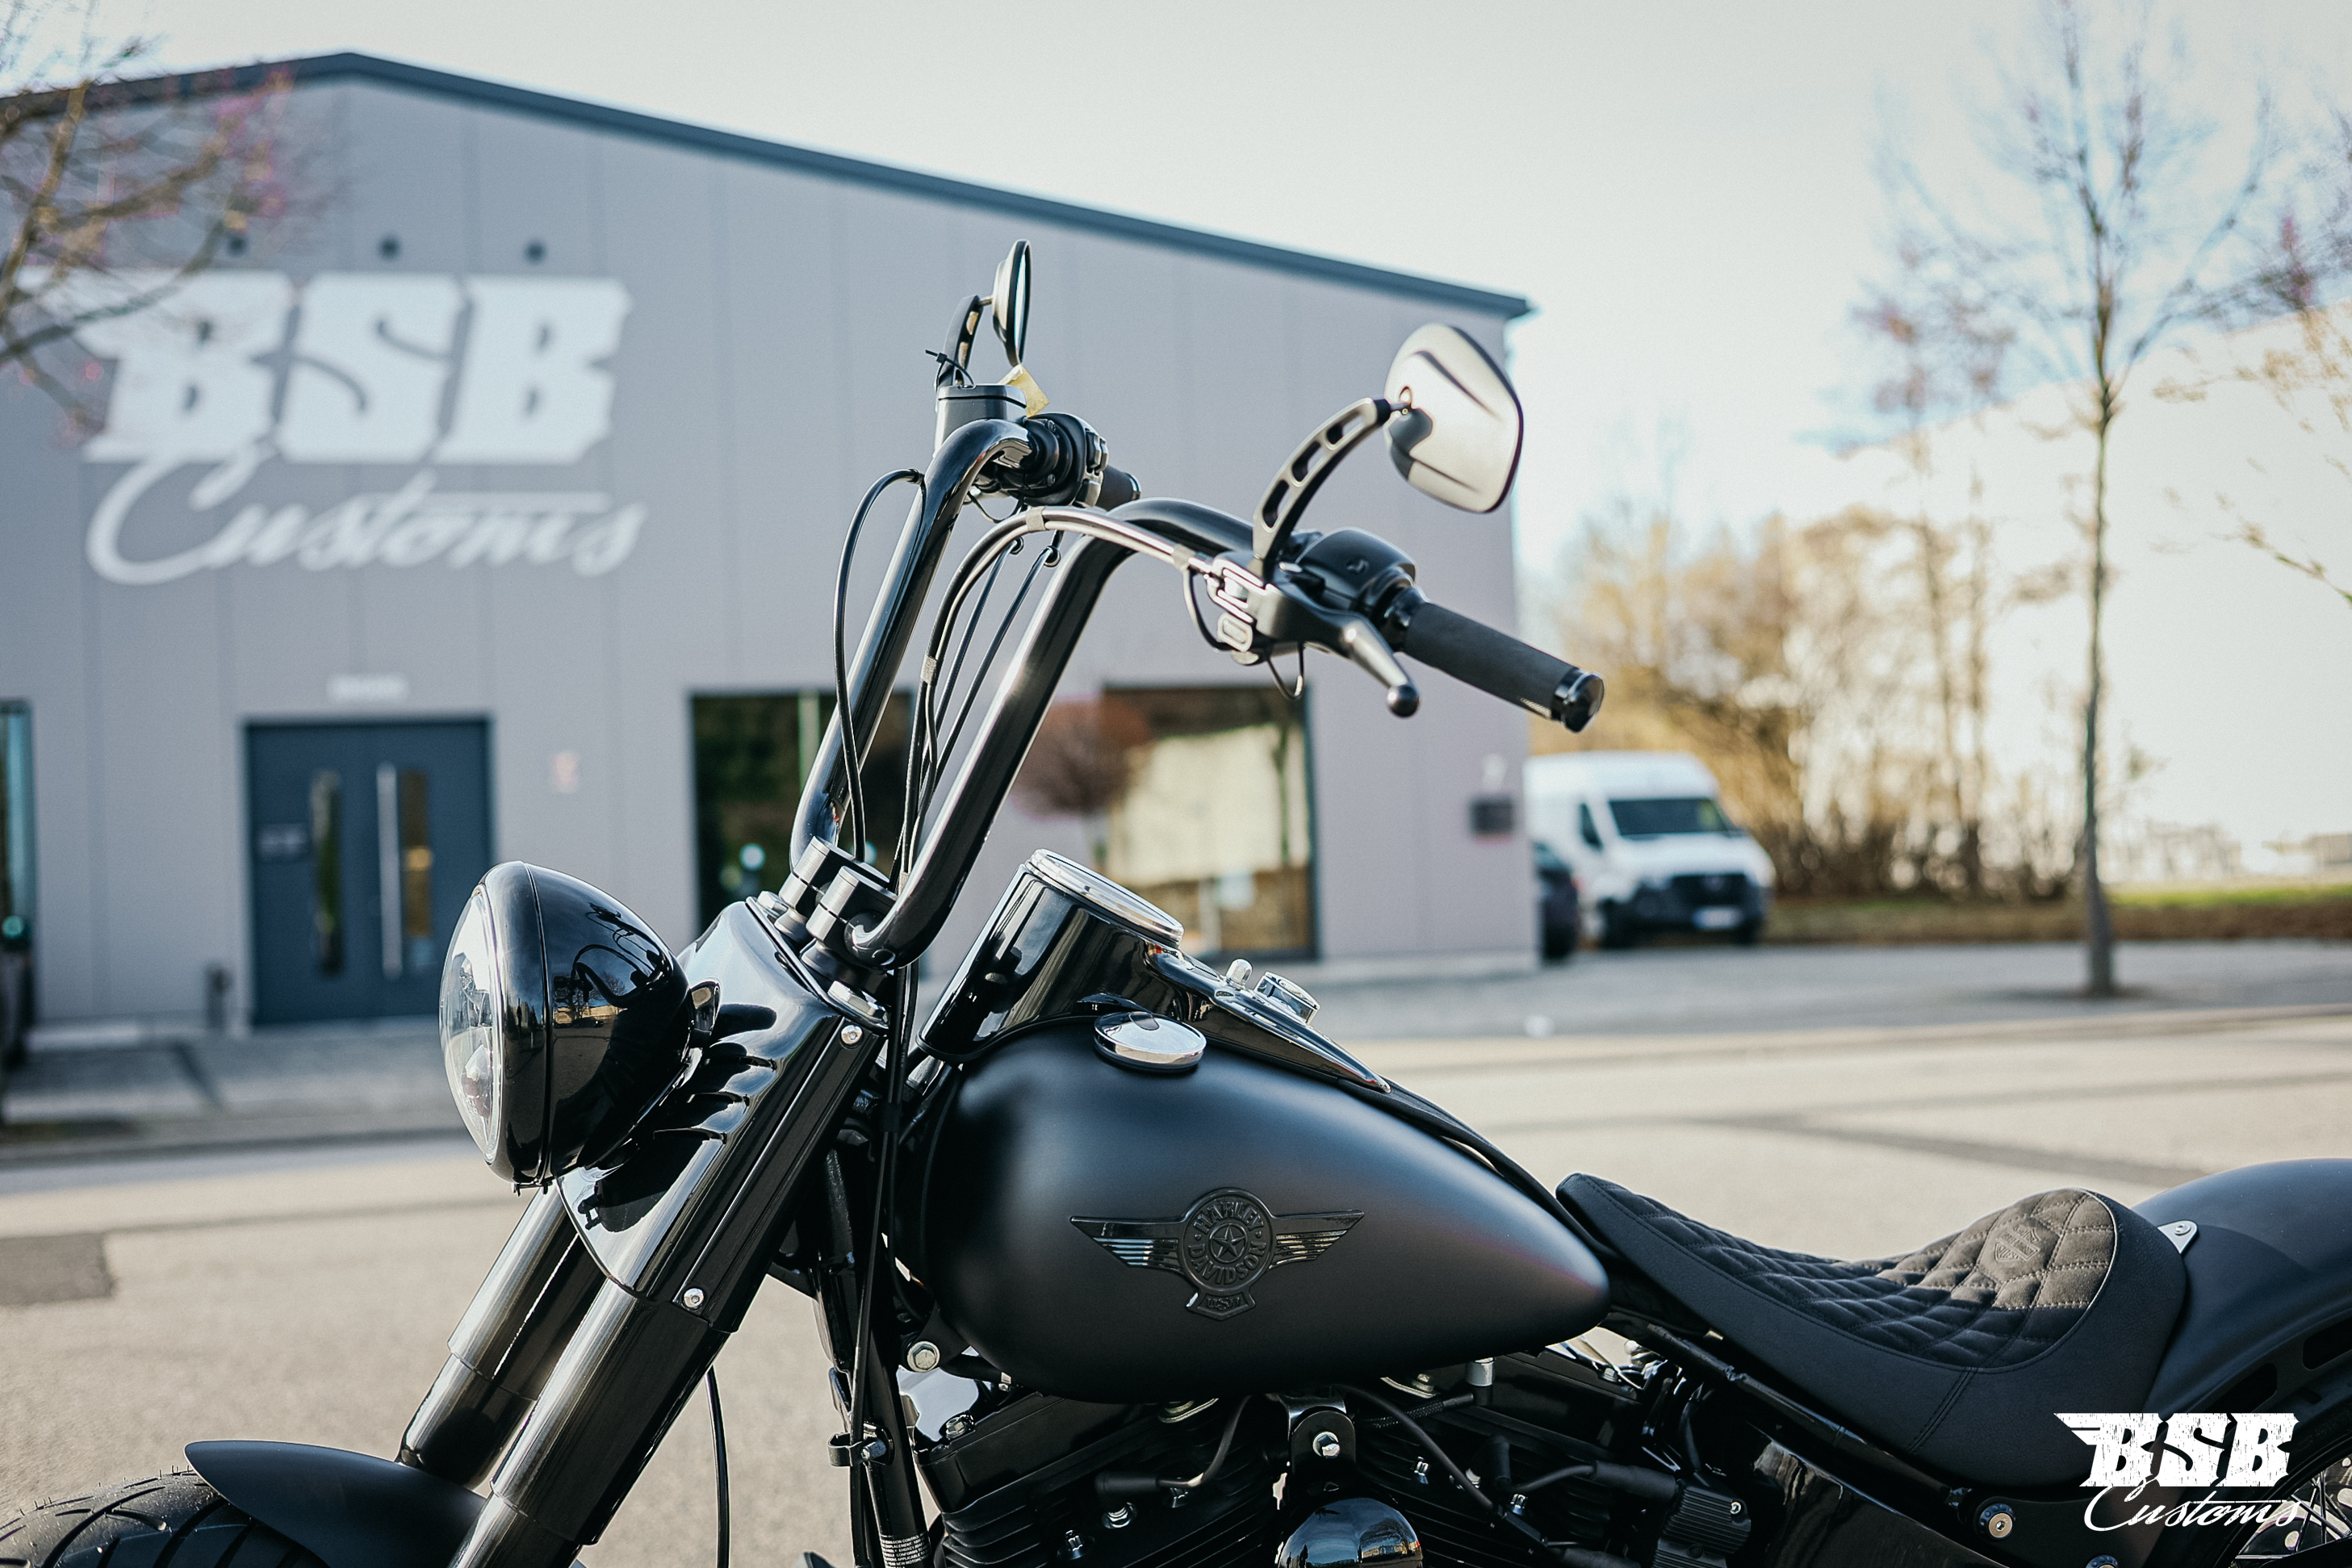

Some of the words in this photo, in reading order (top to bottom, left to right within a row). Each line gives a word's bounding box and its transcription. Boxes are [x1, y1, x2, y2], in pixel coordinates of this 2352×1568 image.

[11, 269, 632, 466] BSB
[85, 445, 646, 585] Customs
[1194, 1198, 1264, 1235] HARLEY
[1188, 1241, 1266, 1285] DAVIDSON
[1207, 1297, 1240, 1310] USA
